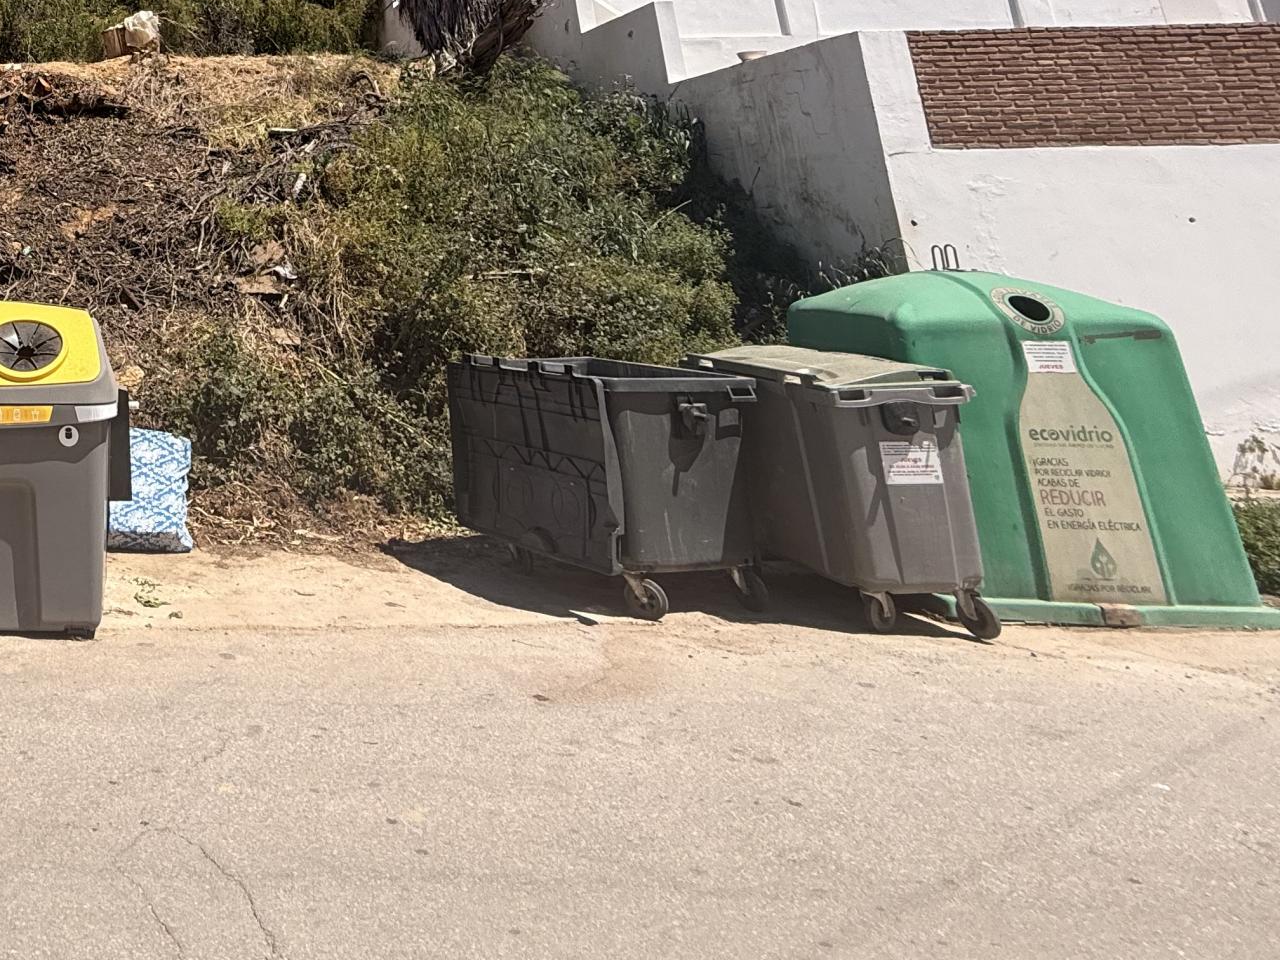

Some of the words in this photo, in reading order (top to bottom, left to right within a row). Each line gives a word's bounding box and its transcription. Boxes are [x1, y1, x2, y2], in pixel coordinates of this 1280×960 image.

[1030, 320, 1062, 334] VIDRIO
[1029, 425, 1113, 442] ecovidrio
[1034, 468, 1050, 476] POR
[1050, 468, 1084, 477] RECICLAR
[1037, 478, 1067, 488] ACABAS
[1069, 479, 1081, 488] DE
[1040, 488, 1106, 507] REDUCIR
[1044, 507, 1055, 517] EL
[1056, 508, 1084, 518] GASTO
[1046, 519, 1060, 530] EN
[1061, 519, 1097, 530] ENERGÍA
[1098, 520, 1142, 532] ELÉCTRICA
